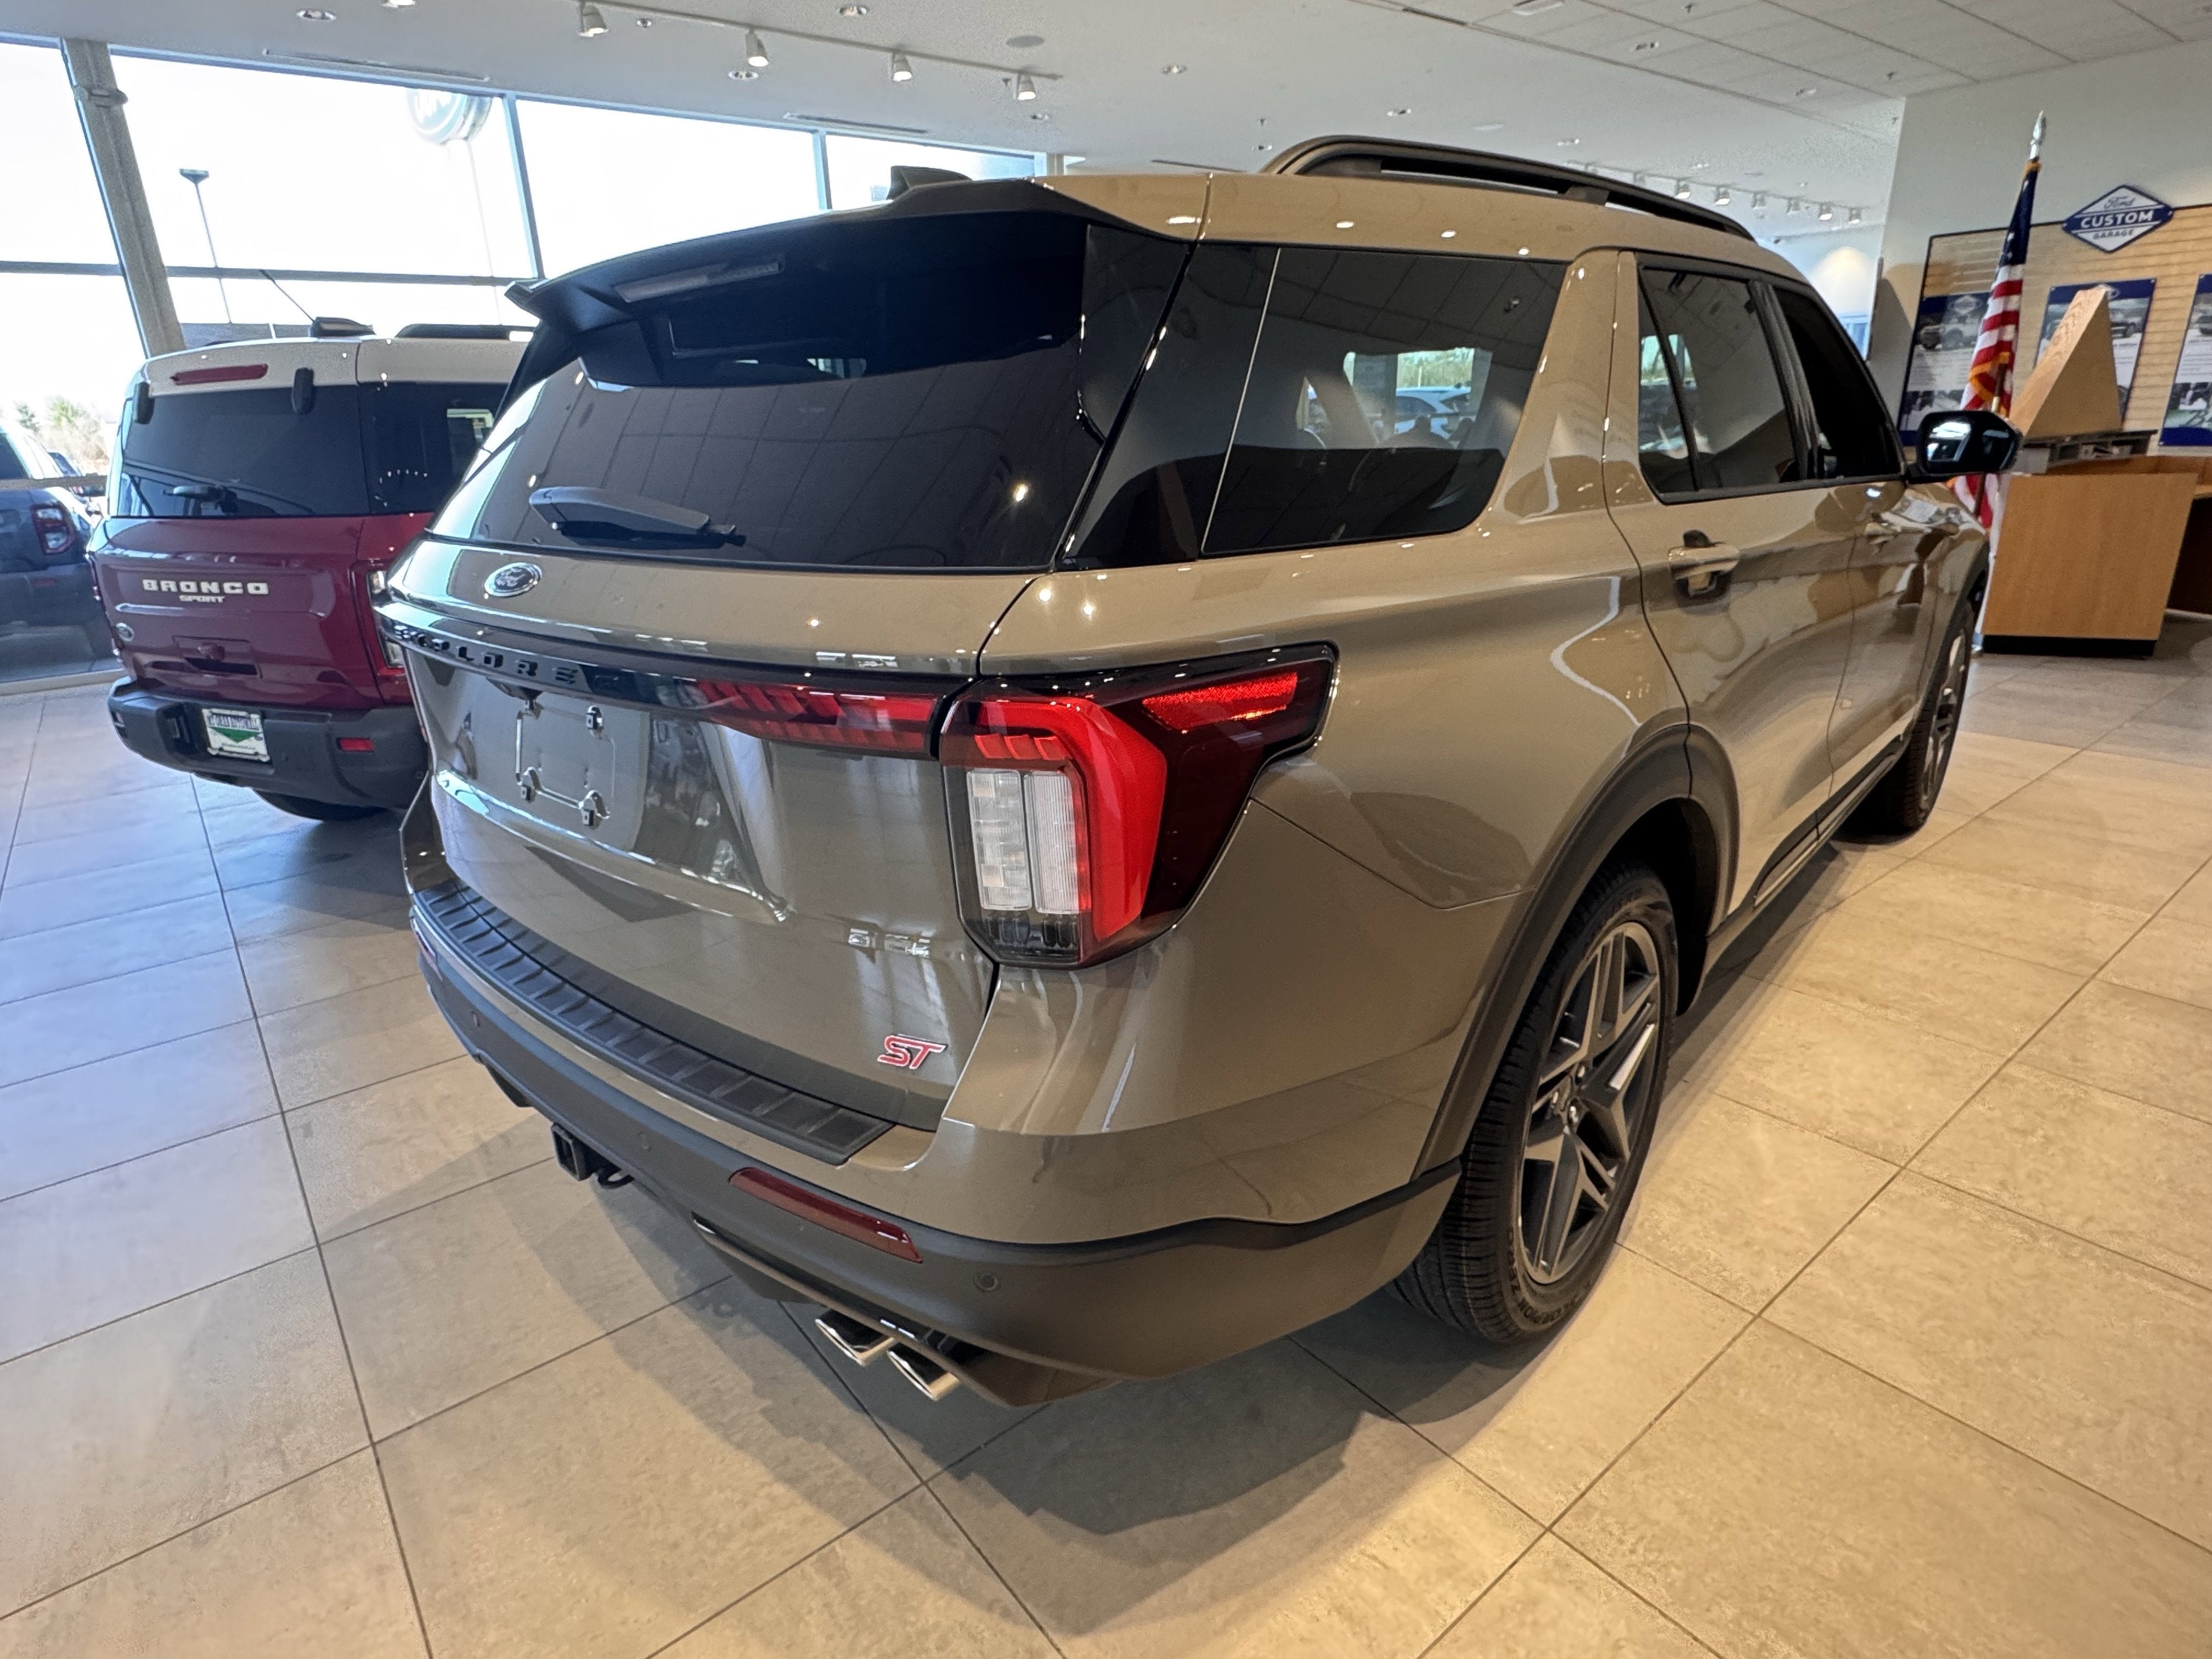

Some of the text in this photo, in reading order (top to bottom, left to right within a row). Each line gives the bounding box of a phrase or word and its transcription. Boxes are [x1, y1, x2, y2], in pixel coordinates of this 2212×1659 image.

[2103, 196, 2136, 209] Ford
[2080, 210, 2154, 229] CUSTOM
[2092, 229, 2135, 240] GARAGE
[143, 579, 269, 595] BRONCO
[179, 595, 225, 603] SPORT
[877, 1034, 947, 1069] ST
